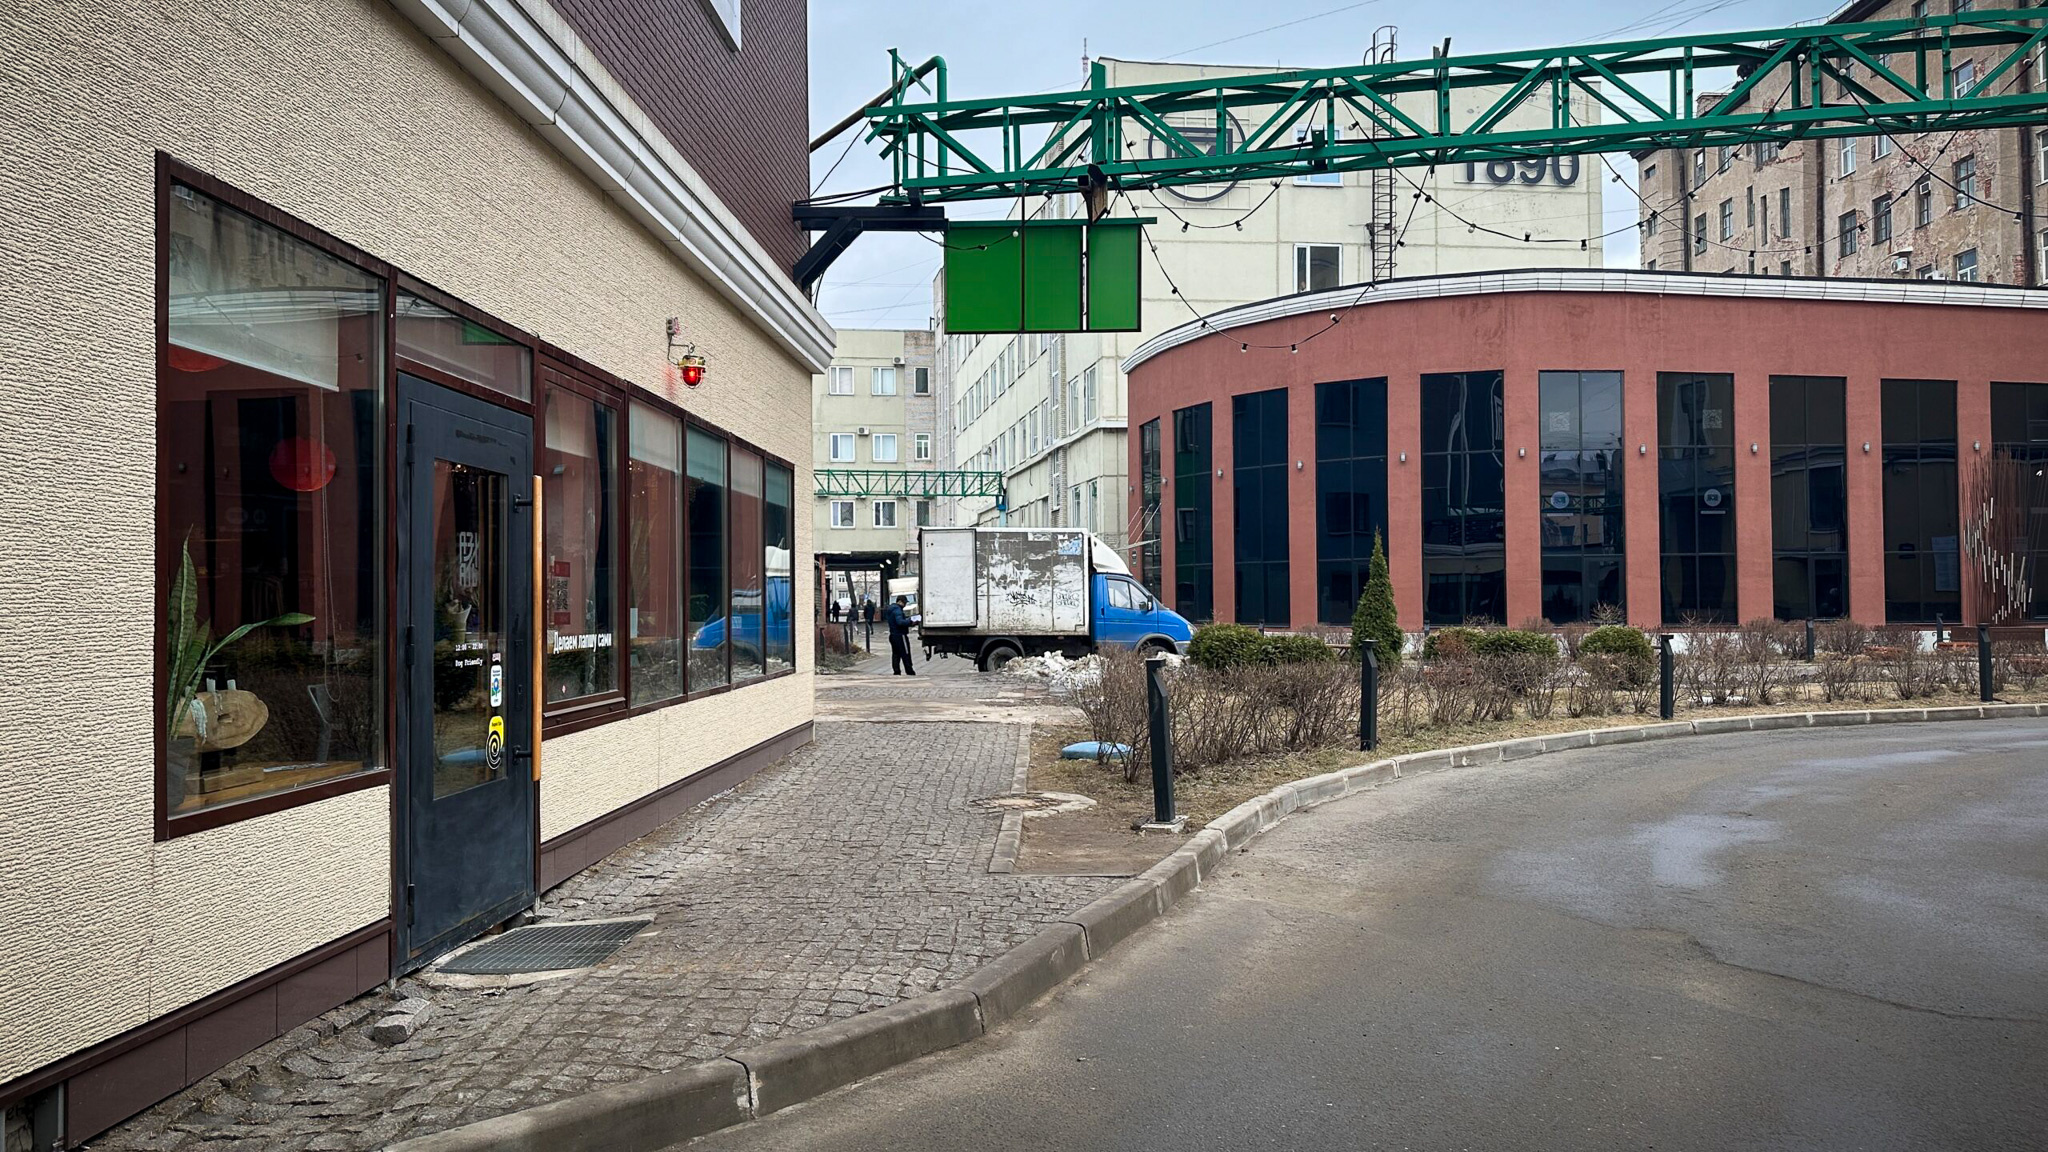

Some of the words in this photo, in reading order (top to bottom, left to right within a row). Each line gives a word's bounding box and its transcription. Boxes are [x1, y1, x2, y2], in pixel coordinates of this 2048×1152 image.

[1467, 148, 1580, 186] 1890
[553, 631, 578, 654] Делаем
[578, 634, 597, 653] лапшу
[597, 633, 612, 647] сами
